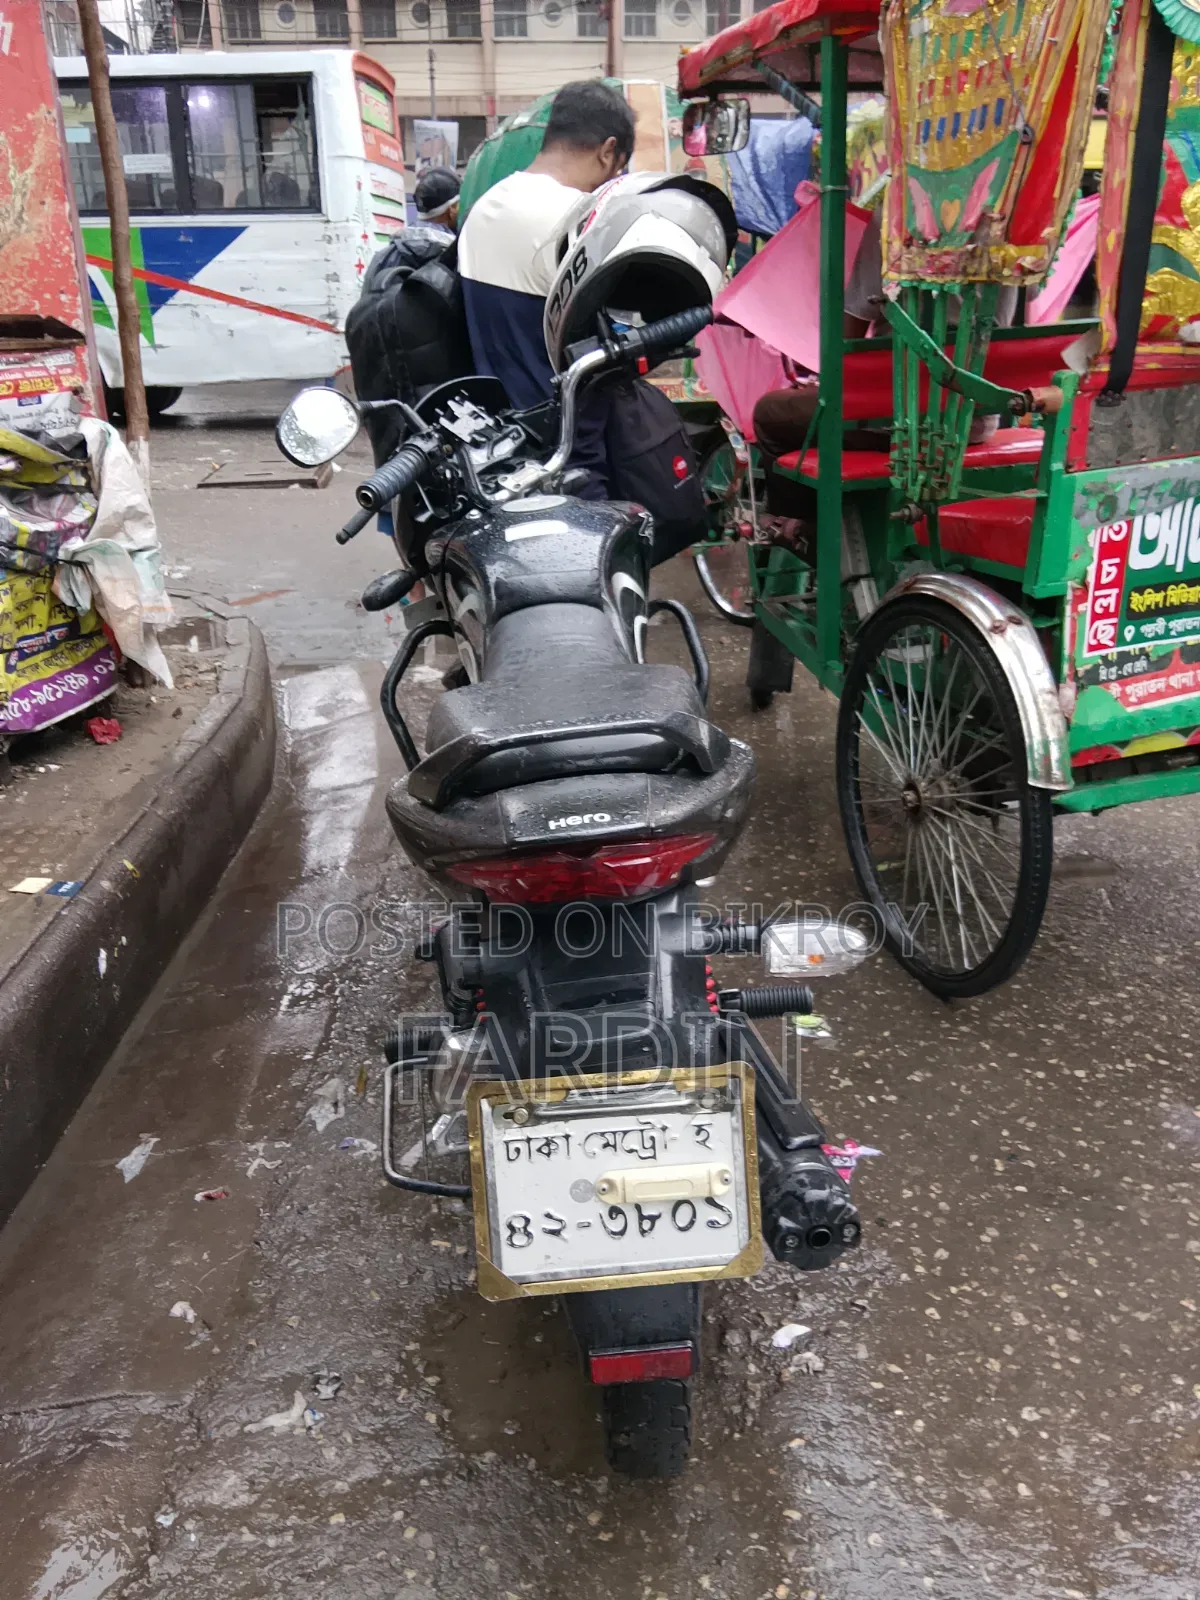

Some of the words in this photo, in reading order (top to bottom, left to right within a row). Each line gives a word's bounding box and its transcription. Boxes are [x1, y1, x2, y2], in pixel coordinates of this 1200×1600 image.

[1129, 588, 1165, 613] ইংলিশ
[548, 812, 612, 830] Hero
[503, 1132, 572, 1162] ঢাকা
[505, 1196, 733, 1249] ৪২-৩৮০১
